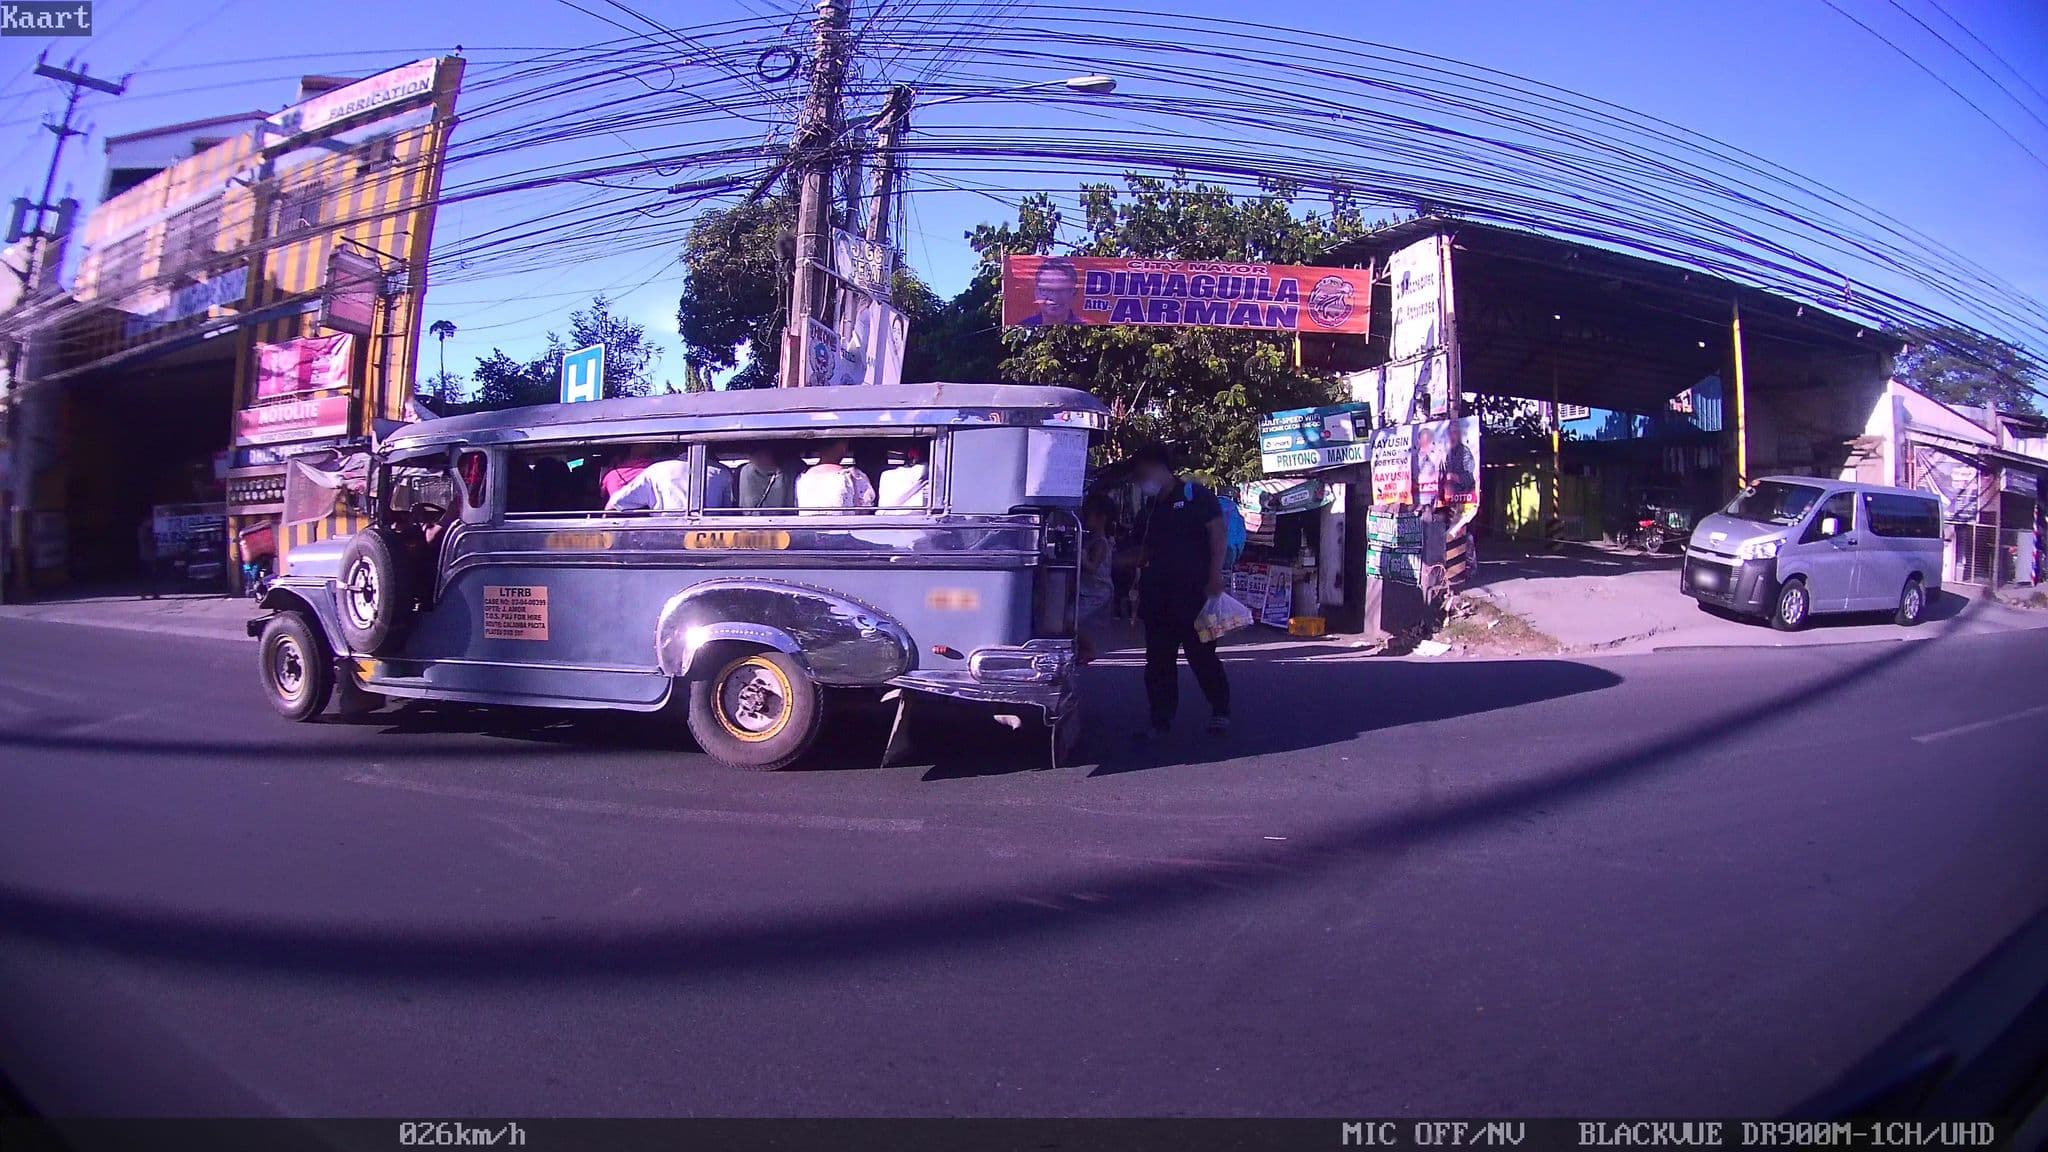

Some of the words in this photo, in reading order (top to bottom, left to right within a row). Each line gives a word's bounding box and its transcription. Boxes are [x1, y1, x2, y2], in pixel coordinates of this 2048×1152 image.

[327, 76, 430, 121] FABRICATION
[1126, 260, 1180, 271] CITY
[1188, 262, 1269, 274] MAYOR
[1083, 270, 1300, 303] DIMAGUILA
[1109, 299, 1299, 328] ARMAN
[258, 404, 319, 424] MOTOLITE
[1371, 437, 1409, 450] AAYUSIN
[1276, 451, 1318, 468] PRITONG
[1326, 446, 1362, 463] MANOK
[1382, 450, 1397, 458] ANG
[1374, 471, 1410, 482] AAYUSIN
[499, 587, 532, 597] LTFRB
